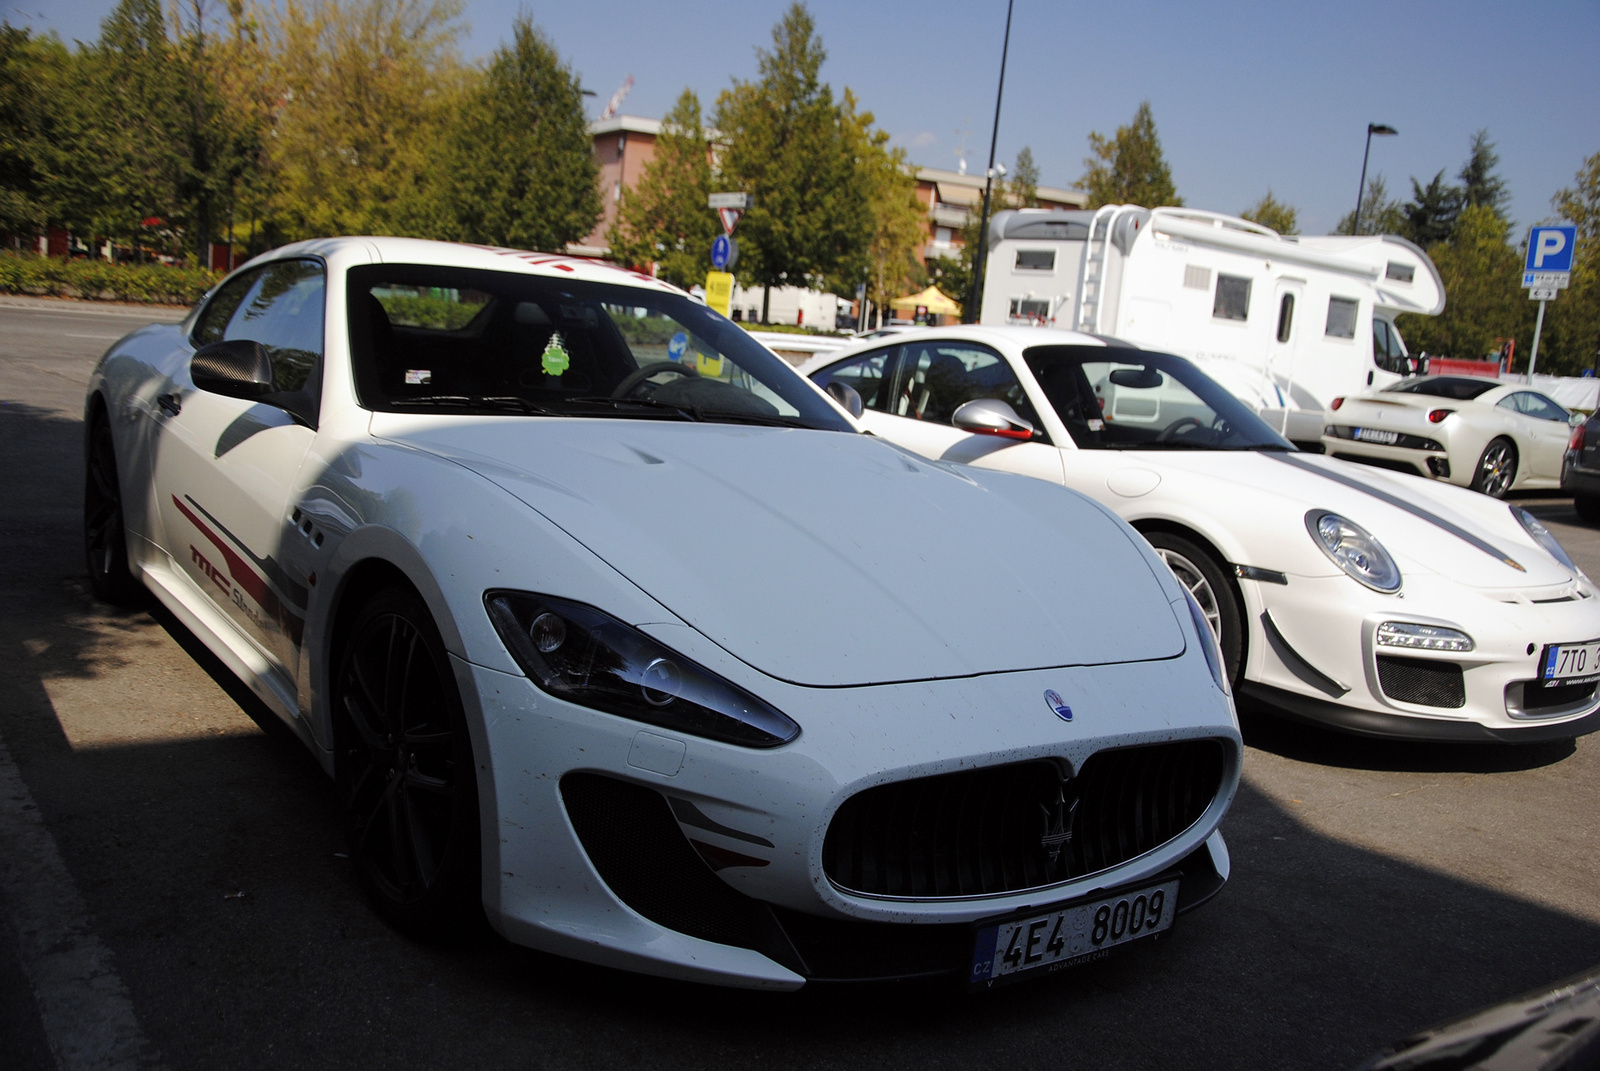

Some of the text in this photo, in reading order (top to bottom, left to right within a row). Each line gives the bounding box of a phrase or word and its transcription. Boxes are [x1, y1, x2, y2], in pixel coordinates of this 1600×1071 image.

[1534, 230, 1566, 268] P
[1546, 666, 1554, 675] CZ
[1003, 889, 1164, 967] 4E4 8009
[973, 961, 990, 975] CZ
[1048, 949, 1109, 972] ADVANTAGE CARS
